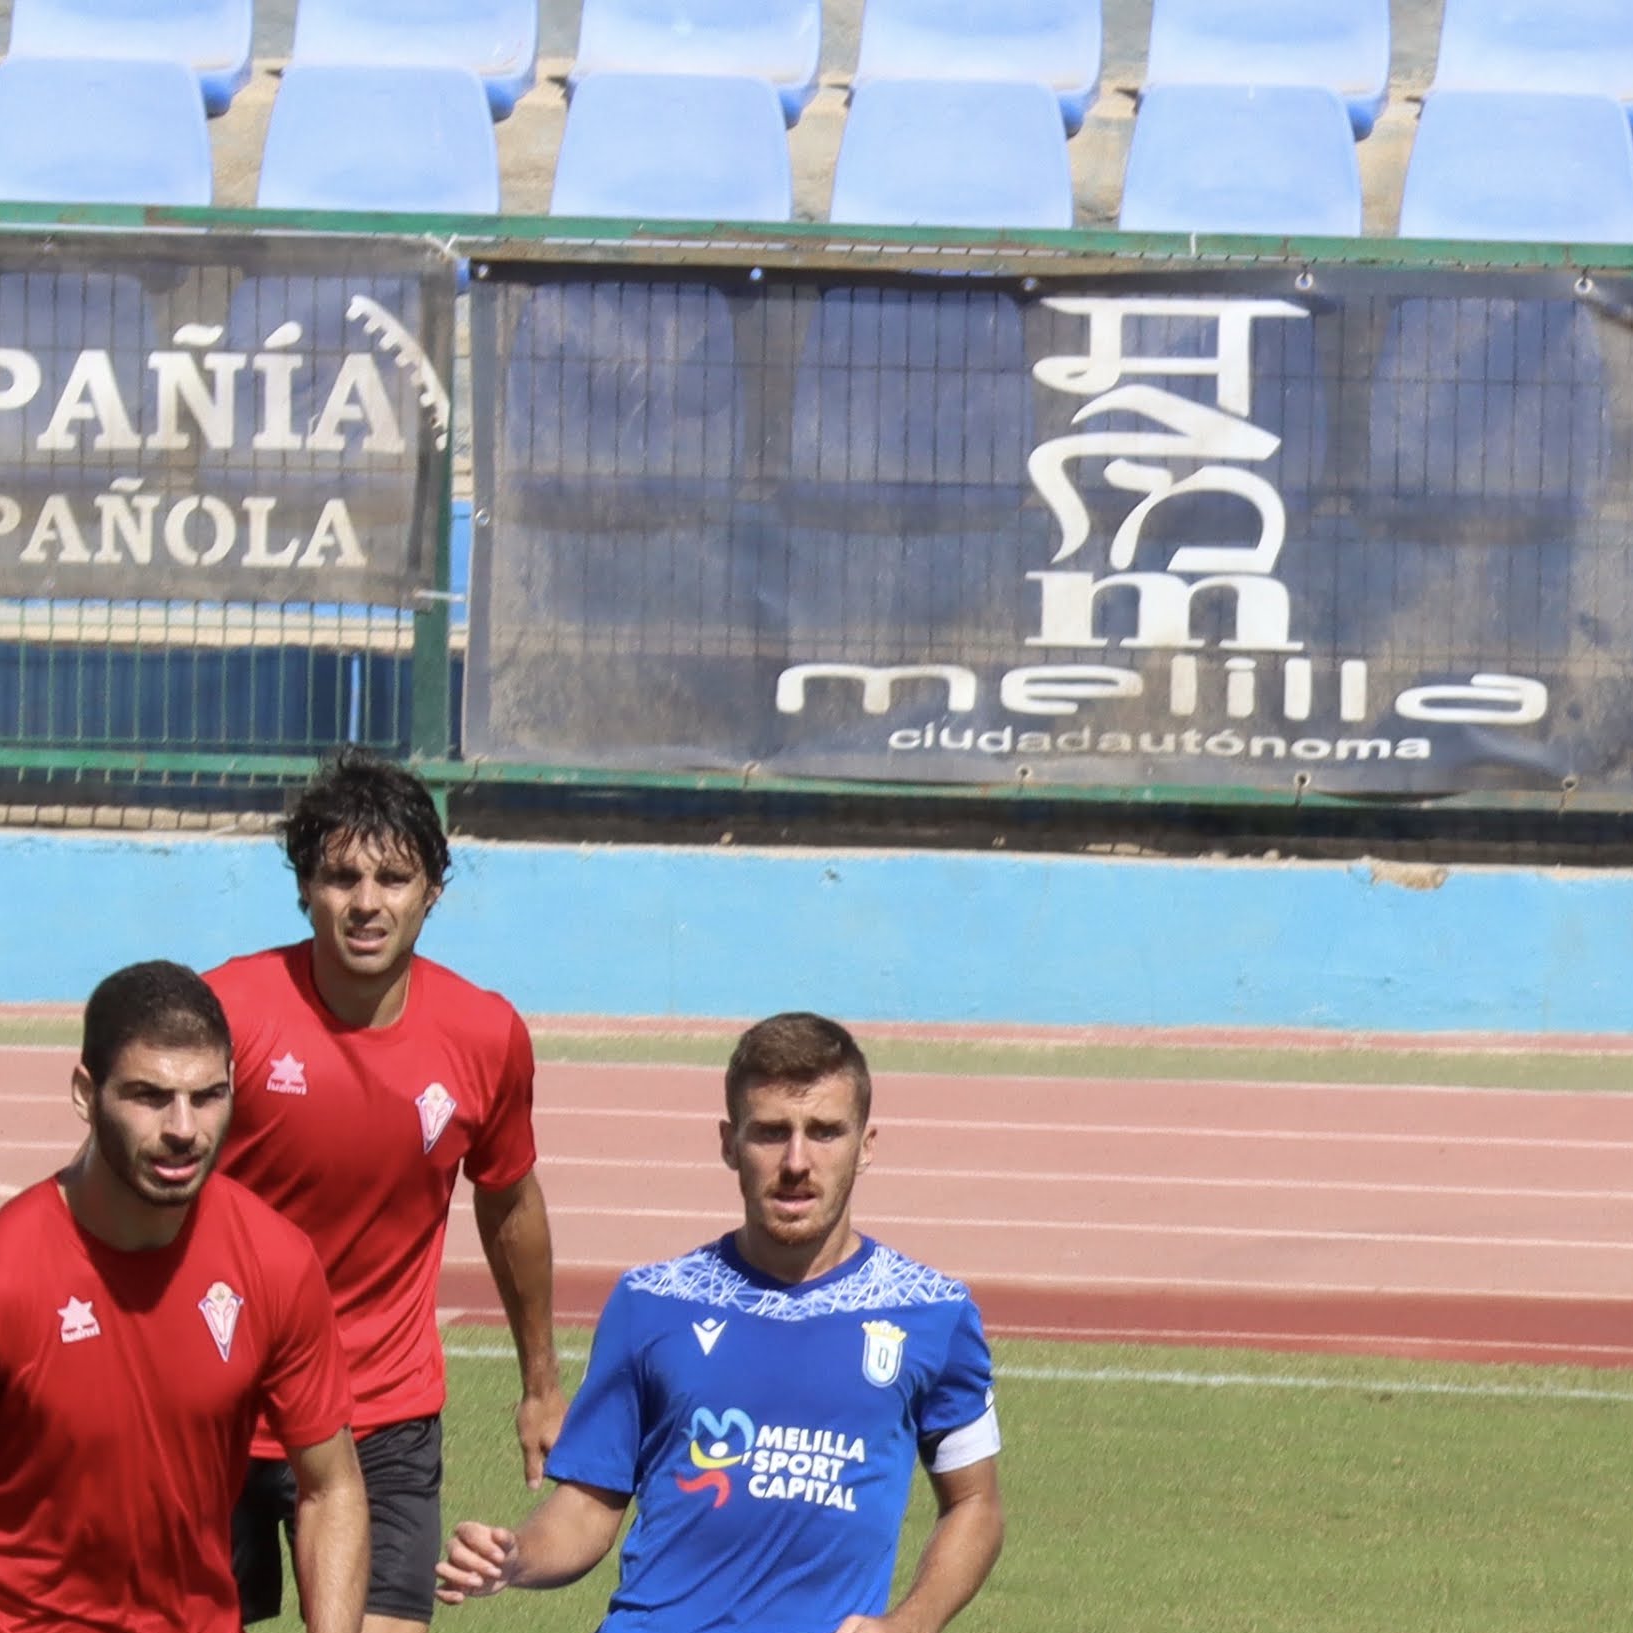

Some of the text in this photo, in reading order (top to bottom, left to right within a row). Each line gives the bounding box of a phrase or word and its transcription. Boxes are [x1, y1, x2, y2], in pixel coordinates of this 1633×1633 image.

[776, 655, 1549, 724] melilla
[888, 716, 1432, 761] ciudadautónoma
[756, 1424, 866, 1462] MELILLA
[752, 1450, 846, 1482] SPORT
[748, 1474, 858, 1512] CAPITAL
